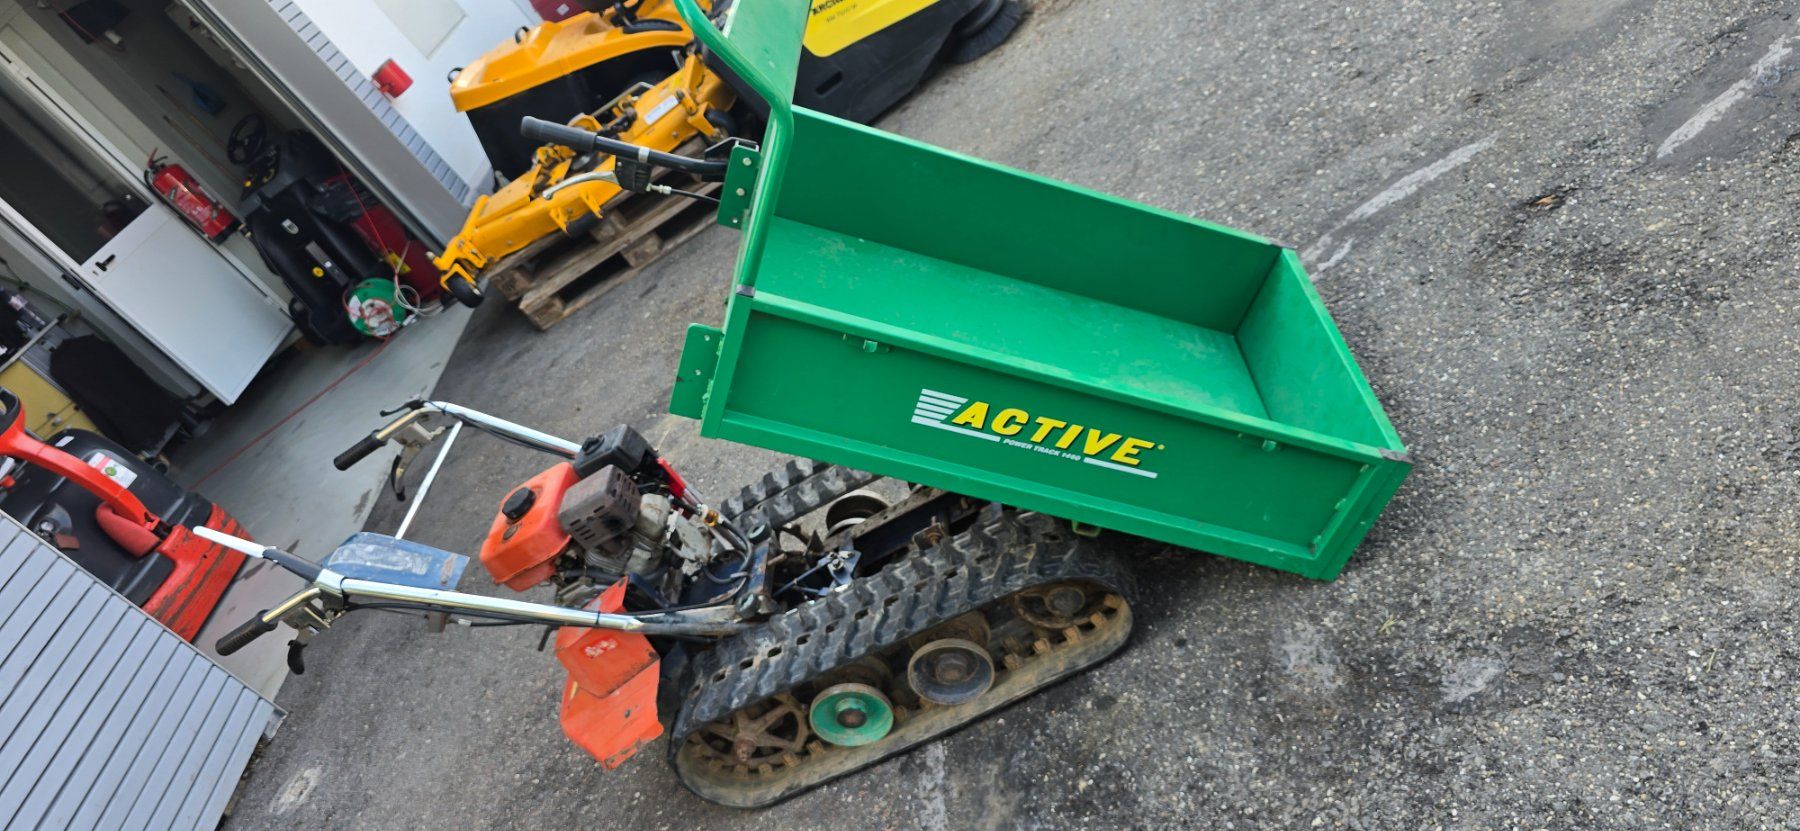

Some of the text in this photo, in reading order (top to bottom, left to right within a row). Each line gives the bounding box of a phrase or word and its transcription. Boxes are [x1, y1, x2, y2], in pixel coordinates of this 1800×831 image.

[951, 401, 1156, 466] ACTIVE
[1003, 438, 1033, 450] POWER
[1034, 445, 1061, 457] TRACK
